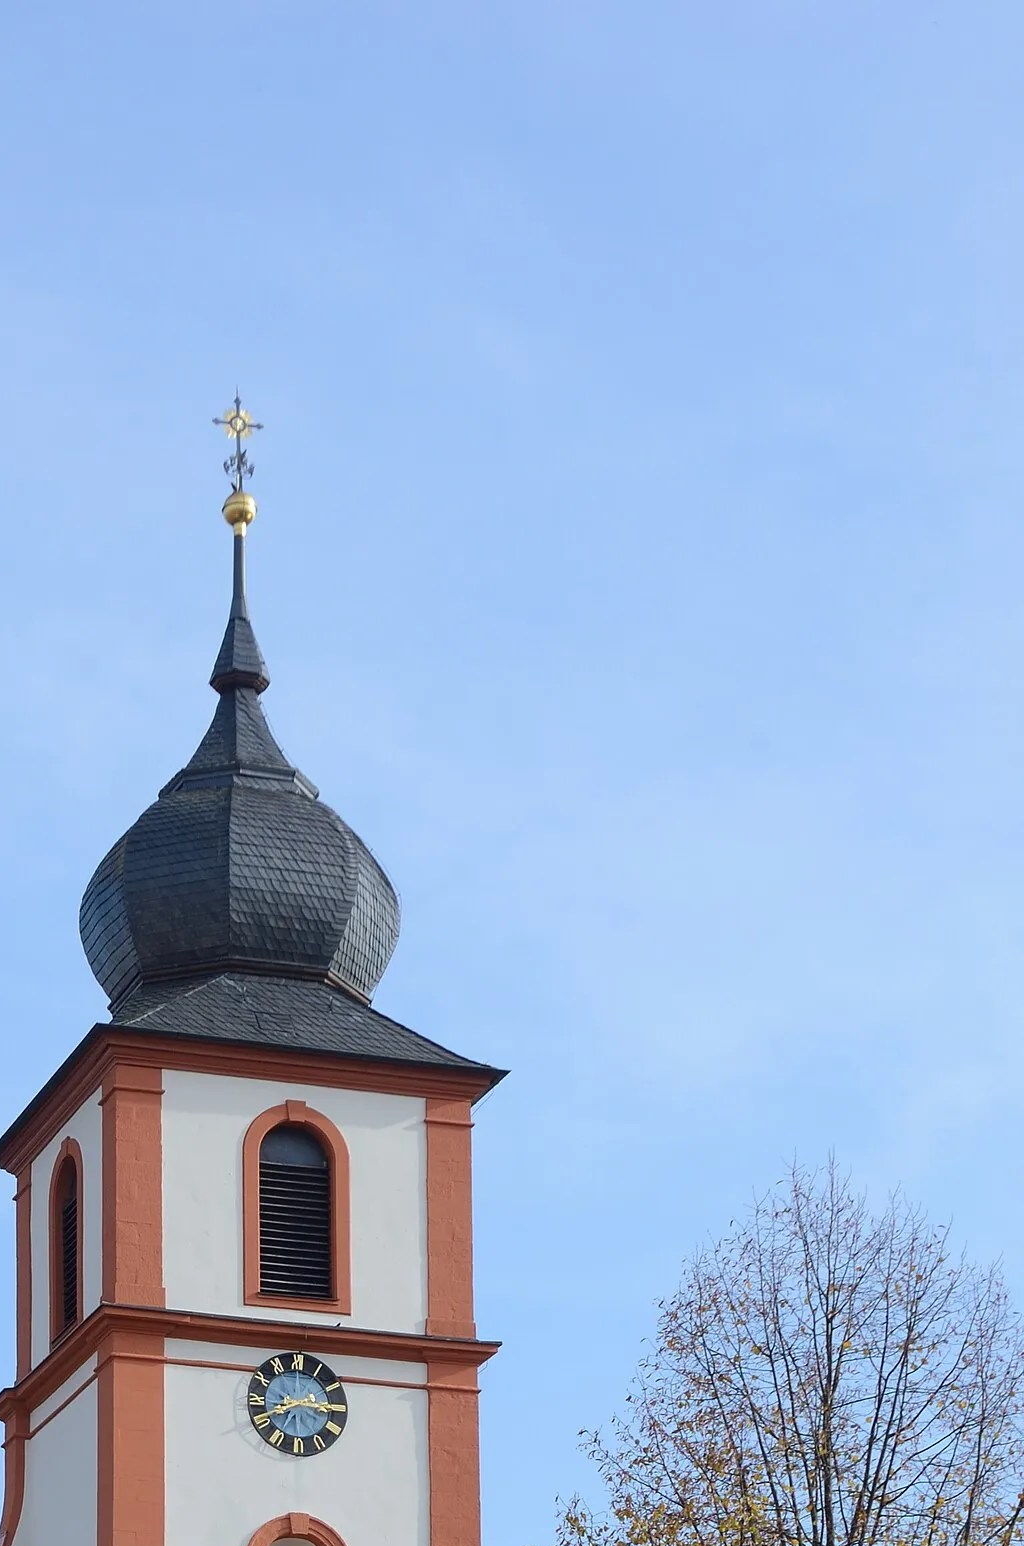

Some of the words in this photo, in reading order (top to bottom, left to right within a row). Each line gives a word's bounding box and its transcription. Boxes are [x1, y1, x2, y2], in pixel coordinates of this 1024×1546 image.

[270, 1357, 284, 1375] XI
[292, 1354, 304, 1370] XII
[314, 1363, 322, 1377] I
[255, 1371, 270, 1387] X
[326, 1382, 341, 1392] II
[249, 1392, 265, 1406] IX
[269, 1429, 285, 1447] VII
[293, 1437, 304, 1453] VI
[313, 1434, 326, 1450] V
